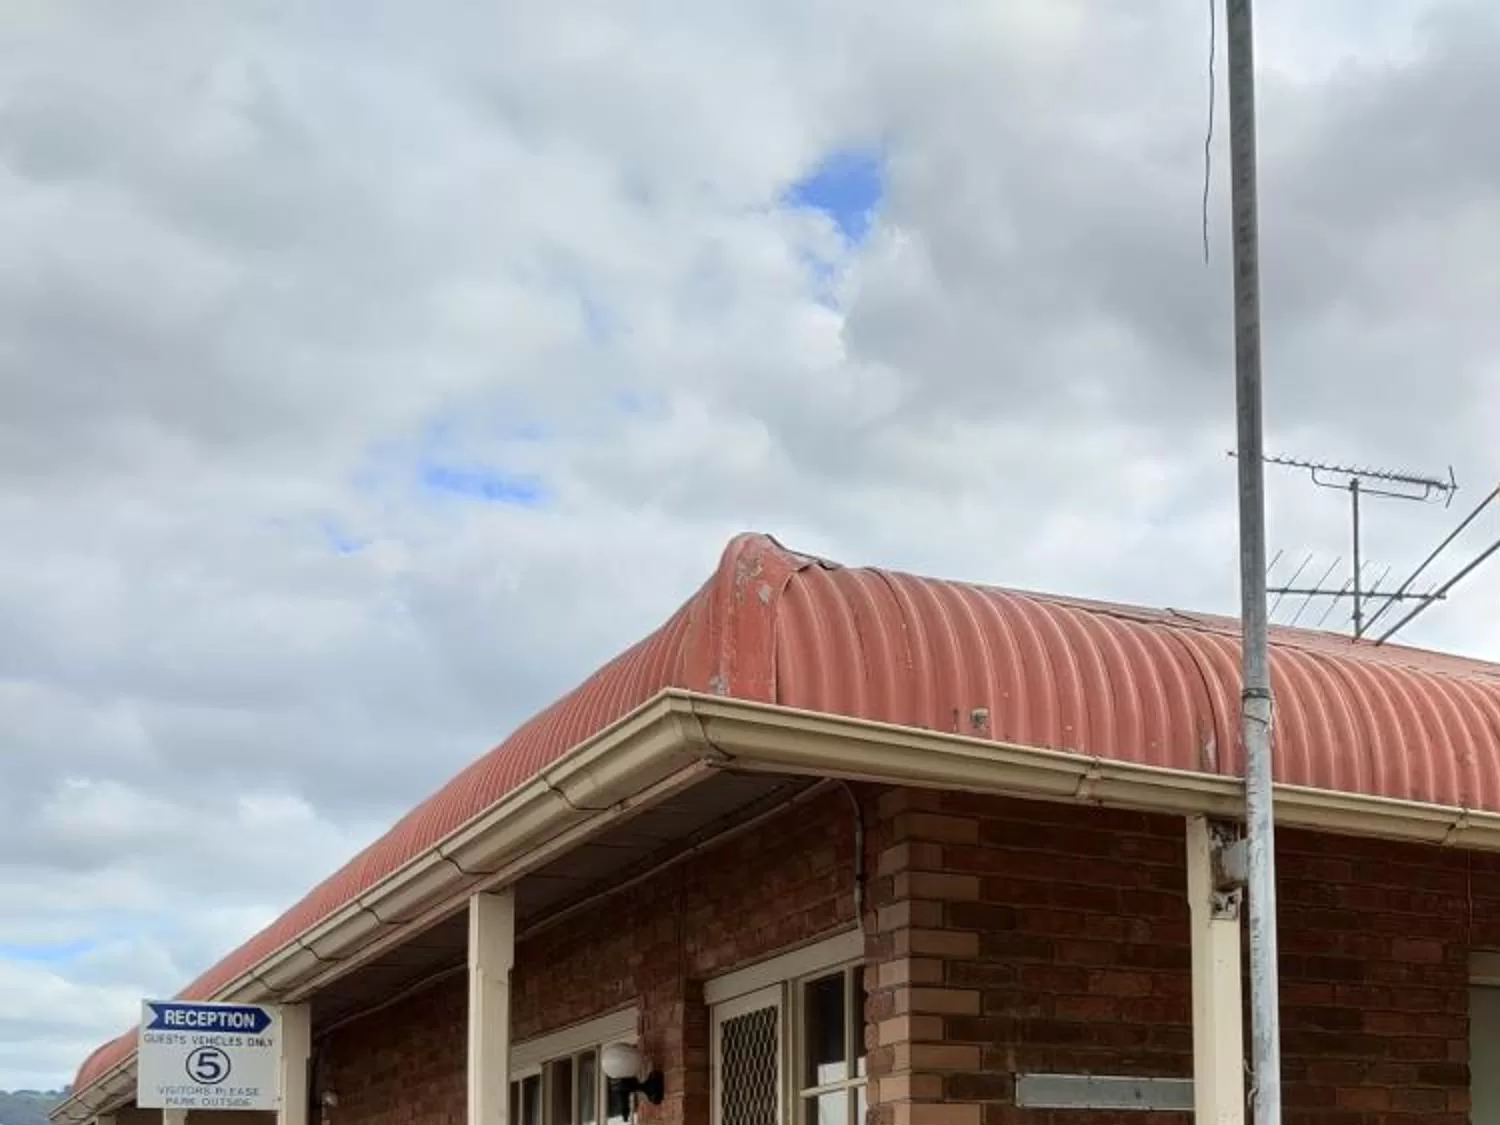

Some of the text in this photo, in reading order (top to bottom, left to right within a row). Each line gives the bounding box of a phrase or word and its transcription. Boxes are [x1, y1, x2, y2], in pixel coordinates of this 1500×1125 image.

[164, 1009, 255, 1028] RECEPTION
[143, 1033, 273, 1047] GUESTS VEHICLES ONLY
[195, 1051, 221, 1080] 5
